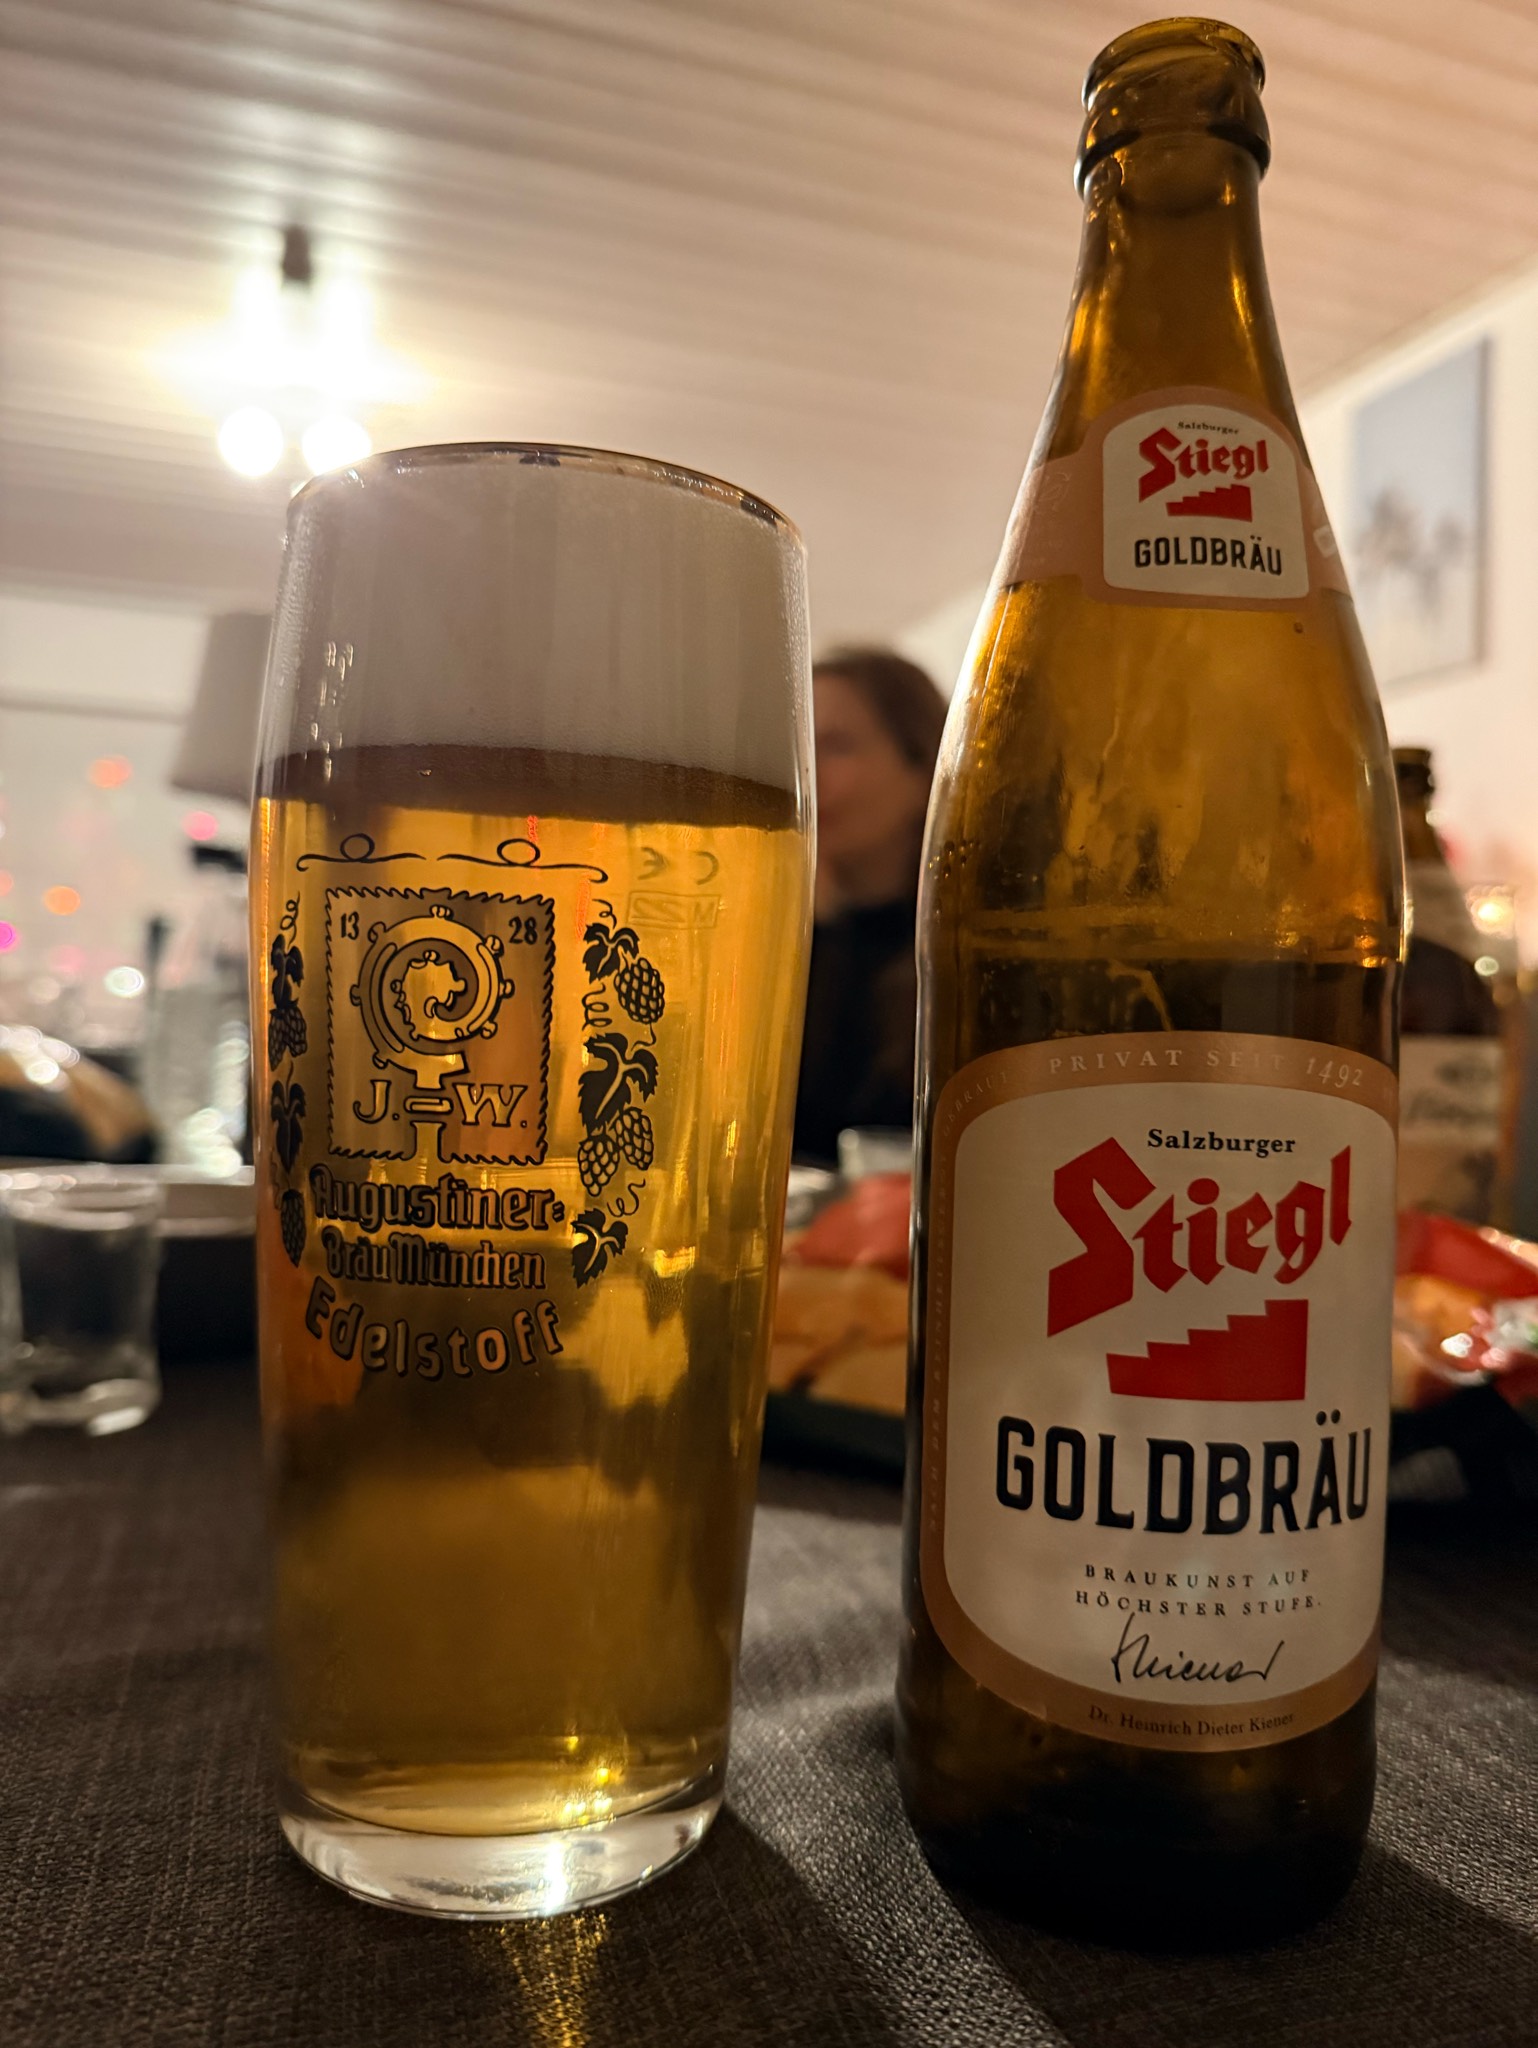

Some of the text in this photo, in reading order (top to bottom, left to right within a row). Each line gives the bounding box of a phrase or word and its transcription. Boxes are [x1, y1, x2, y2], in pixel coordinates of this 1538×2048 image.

[1177, 421, 1239, 435] Salzburger
[1138, 427, 1270, 503] Stiegl
[1134, 534, 1282, 576] GOLDBRÄU
[339, 912, 361, 940] 13
[507, 916, 539, 945] 28
[1049, 1050, 1183, 1075] PRIVAT
[1306, 1056, 1364, 1088] 1492
[1147, 1128, 1296, 1159] Salzburger
[1046, 1136, 1353, 1338] Stiegl
[305, 1275, 565, 1381] Edelstoff
[995, 1408, 1372, 1536] GOLDBRÄU
[1085, 1564, 1311, 1589] BRAUKUNST AUF
[1075, 1590, 1227, 1617] HÖCHSTER
[1120, 1711, 1192, 1736] Heinrich
[1197, 1720, 1244, 1737] Dieter
[1249, 1712, 1294, 1733] Kiener
